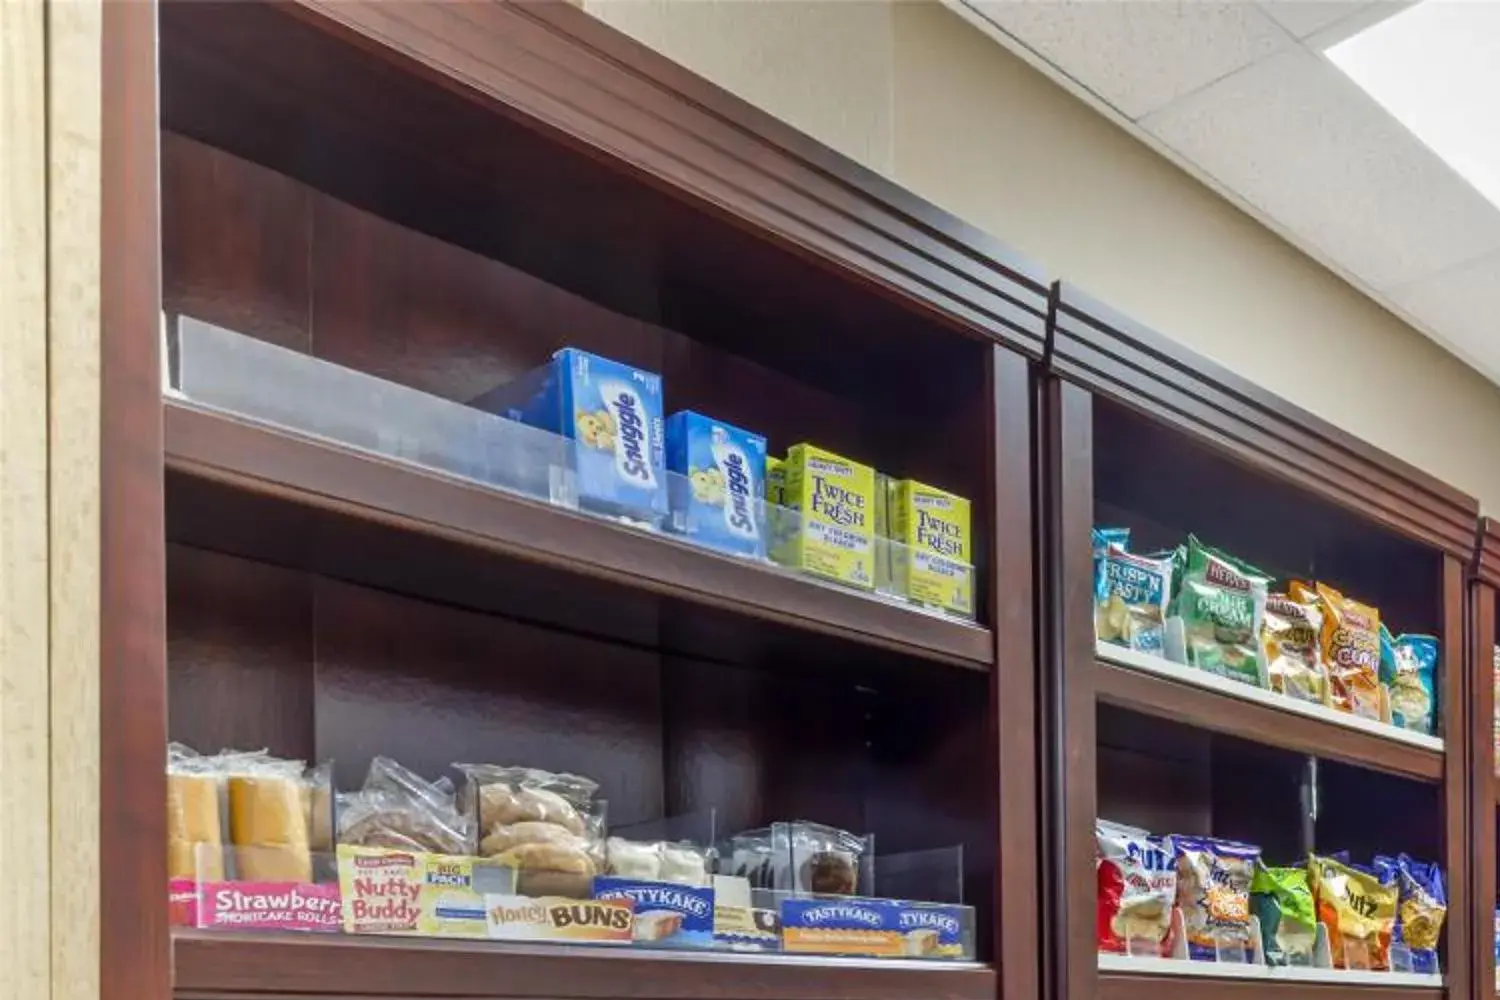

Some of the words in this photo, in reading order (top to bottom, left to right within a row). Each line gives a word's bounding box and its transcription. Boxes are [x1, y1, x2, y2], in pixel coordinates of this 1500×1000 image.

[612, 392, 649, 481] Snuggle
[723, 453, 753, 533] Snuggle
[812, 475, 865, 507] TWICE
[812, 493, 865, 527] FRESH
[916, 509, 962, 538] TWICE
[916, 526, 963, 555] FRESH
[215, 889, 341, 913] Strawberr
[353, 878, 422, 902] Nutty
[352, 898, 423, 924] Buddy
[550, 904, 632, 930] BUNS
[806, 905, 882, 926] TASTYKAKE
[899, 911, 958, 932] TYKAKE
